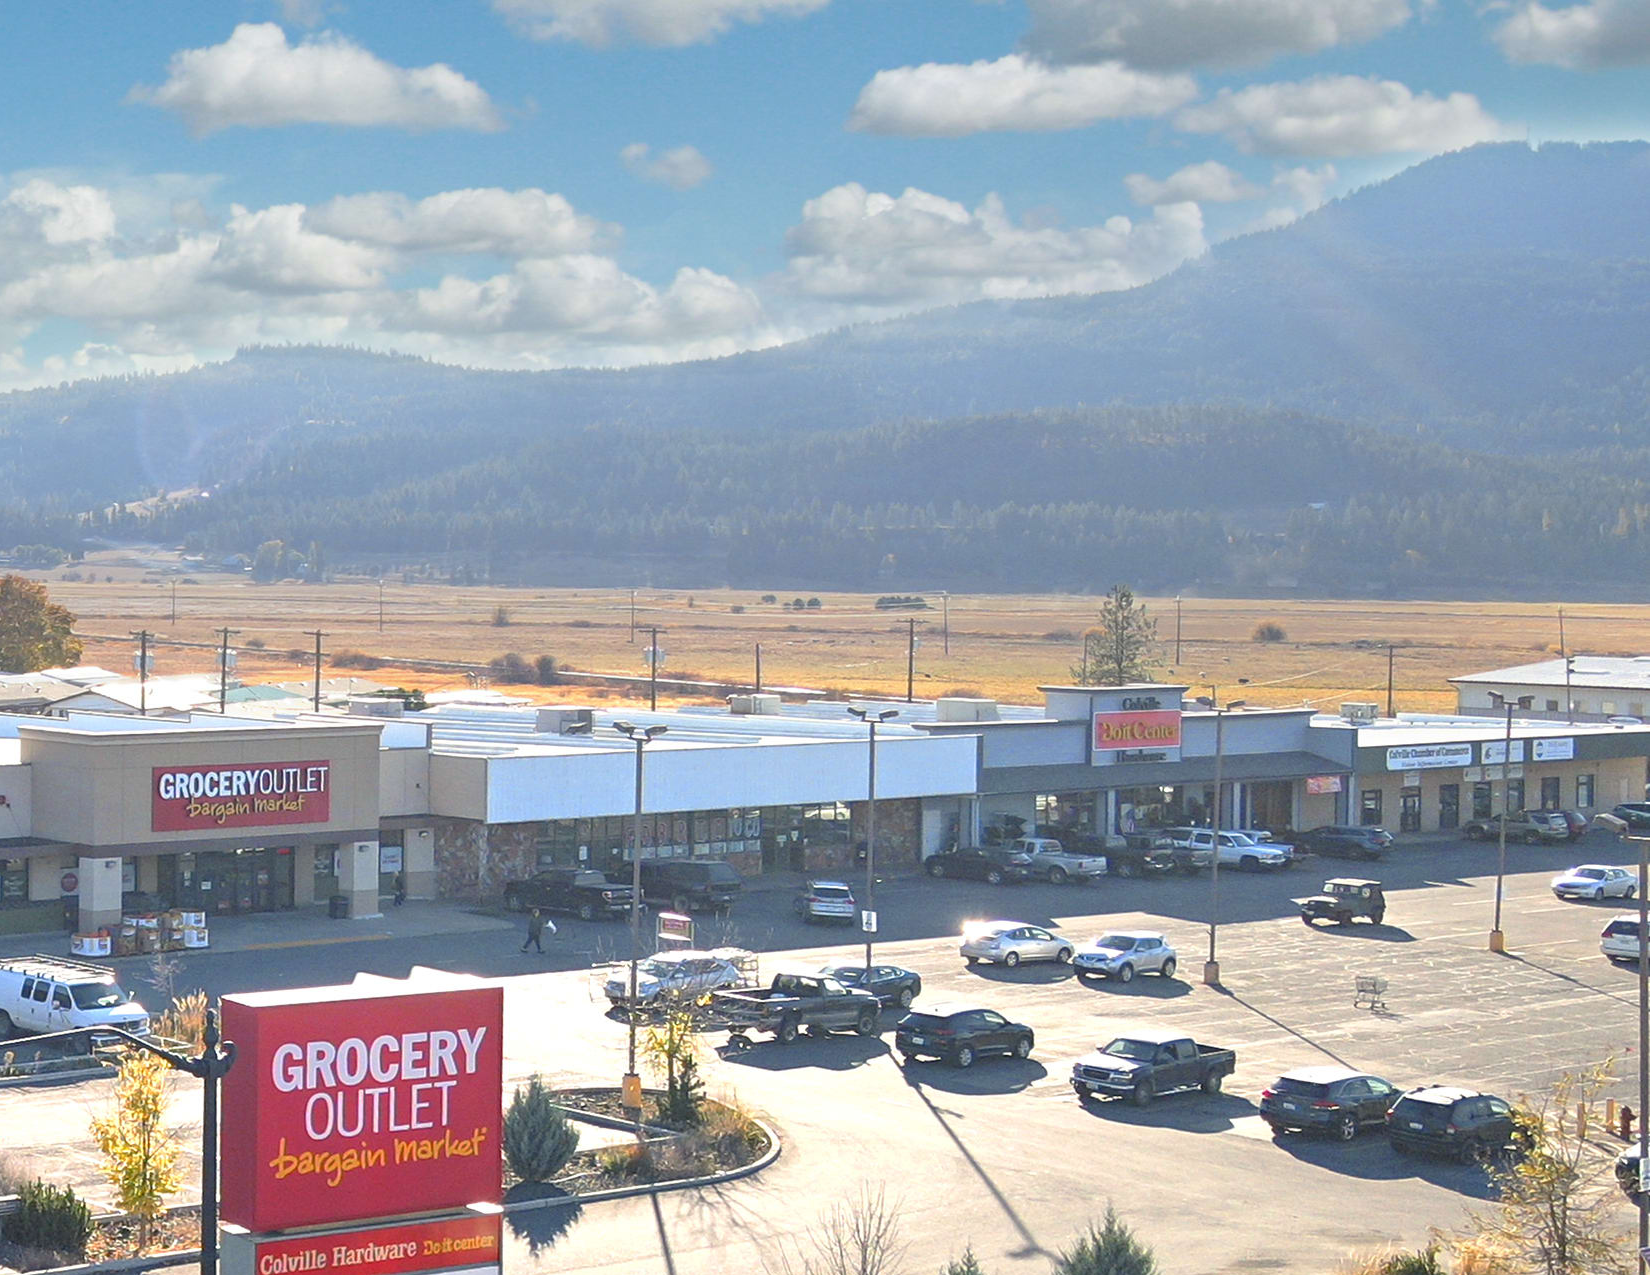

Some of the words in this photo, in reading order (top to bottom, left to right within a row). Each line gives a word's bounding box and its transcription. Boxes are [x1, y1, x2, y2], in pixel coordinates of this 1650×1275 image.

[186, 793, 250, 824] bargain
[254, 793, 306, 814] market
[272, 1026, 487, 1092] GROCERY
[305, 1080, 458, 1140] OUTLET
[269, 1137, 386, 1187] bargain
[395, 1128, 486, 1164] market
[260, 1249, 327, 1275] Colville
[331, 1241, 417, 1267] Hardware
[453, 1235, 495, 1251] center
